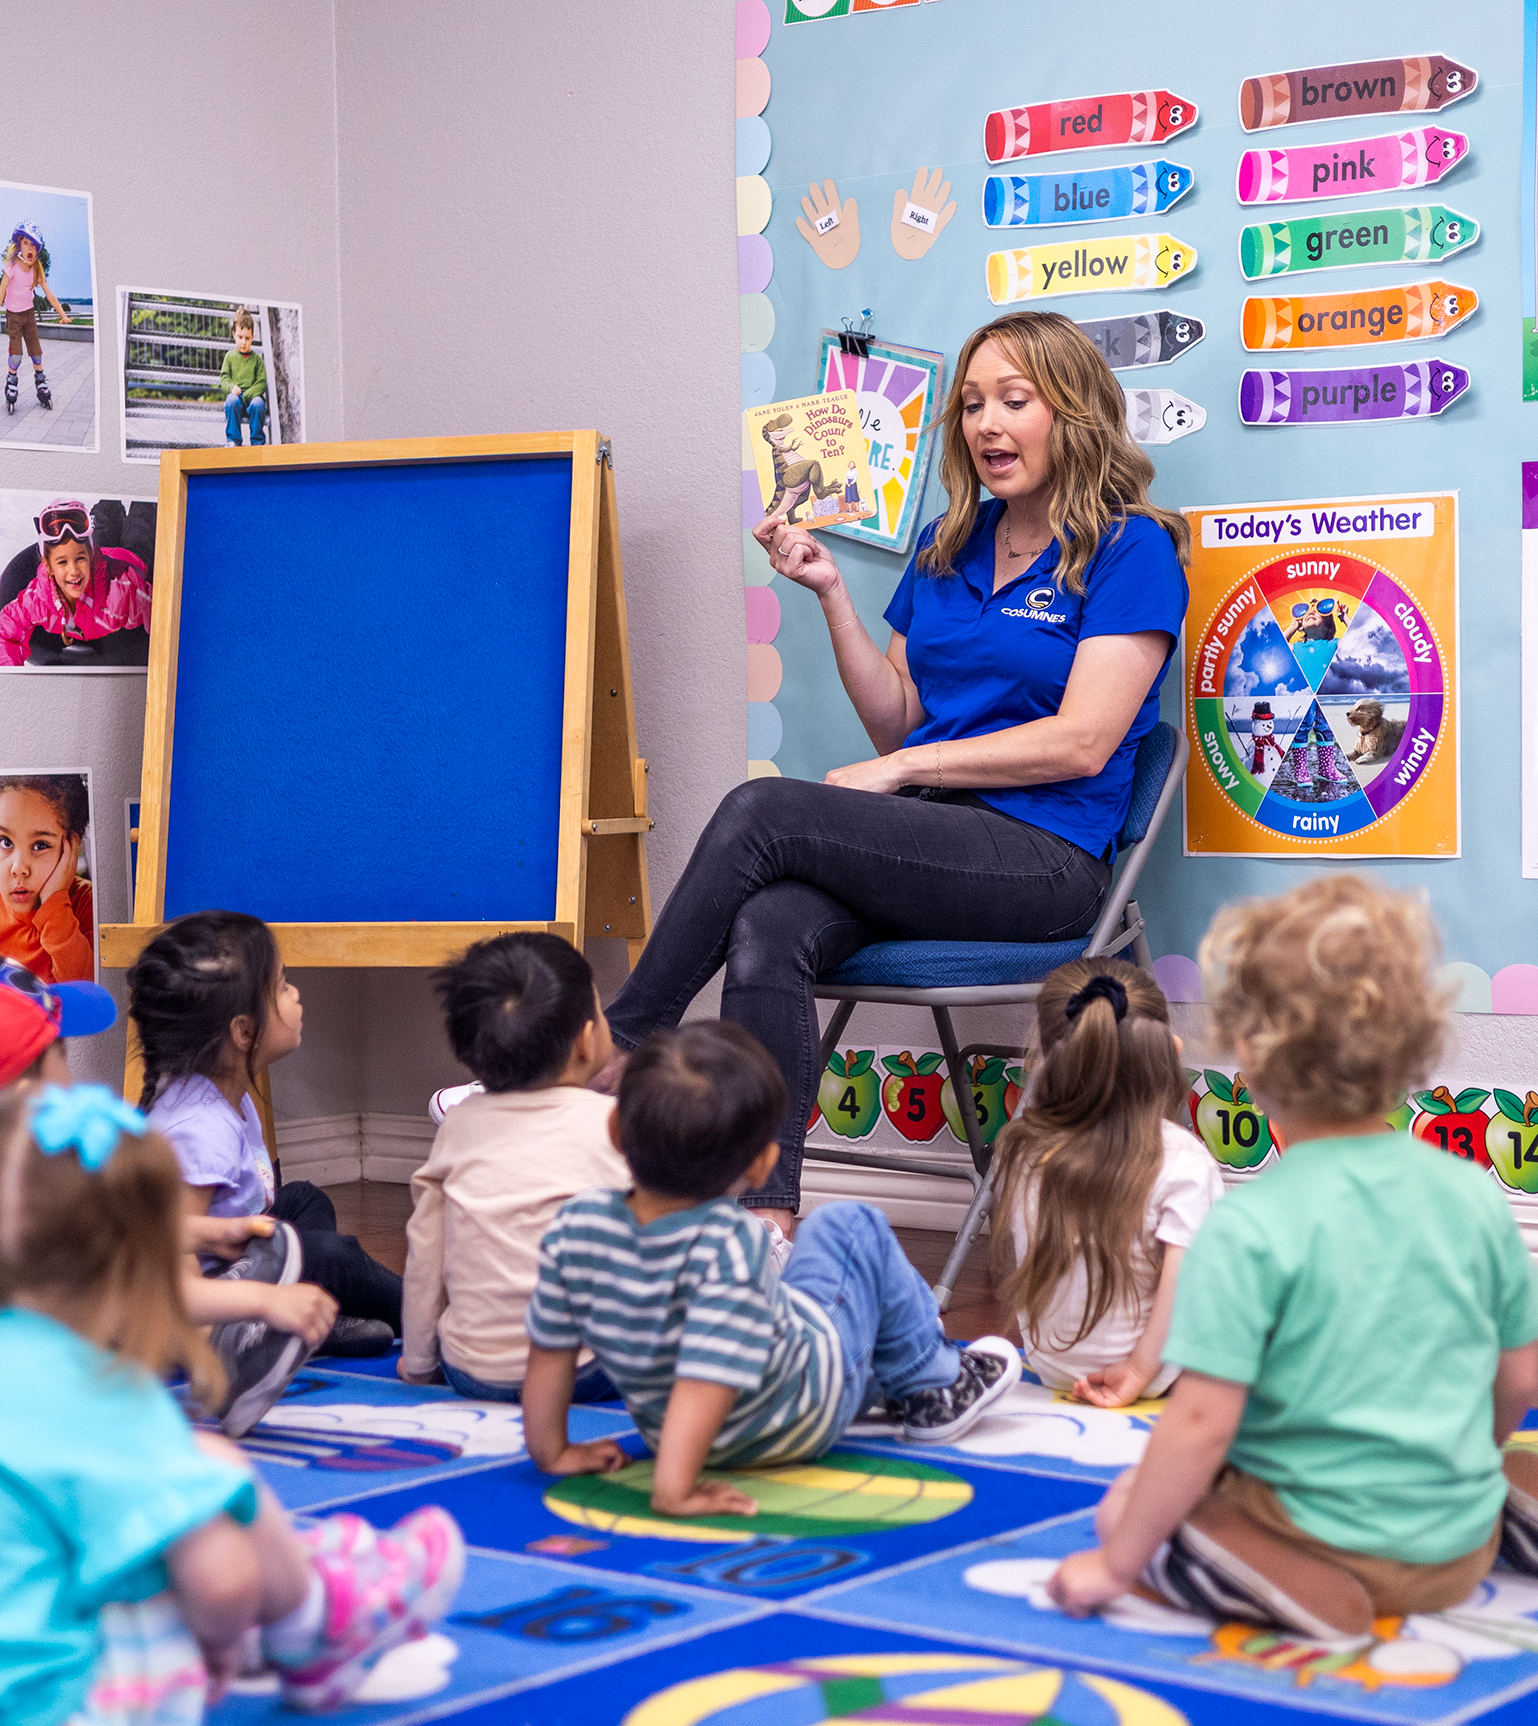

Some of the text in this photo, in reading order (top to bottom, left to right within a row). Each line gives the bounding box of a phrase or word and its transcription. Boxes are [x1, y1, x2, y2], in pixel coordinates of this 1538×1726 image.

[1301, 75, 1397, 107] brown
[1059, 104, 1103, 136] red
[1312, 149, 1376, 192] pink
[1054, 182, 1111, 212] blue
[819, 217, 834, 231] Left
[909, 211, 929, 226] Right
[1305, 223, 1389, 261] green
[1041, 249, 1129, 291] yellow
[1297, 303, 1404, 336] orange
[754, 409, 771, 417] JANE
[772, 405, 794, 414] YOLEN
[801, 400, 821, 408] MARK
[822, 394, 849, 404] TEAGUE
[1302, 373, 1397, 414] purple
[803, 415, 854, 436] Dinosaurs
[805, 404, 847, 421] How Do
[813, 427, 846, 441] Count
[826, 438, 837, 447] to
[820, 445, 845, 459] Ten?
[1214, 507, 1423, 543] Today's Weather
[1286, 560, 1341, 580] sunny
[1001, 607, 1067, 623] COSUMNES
[1200, 585, 1257, 693] partly sunny
[1394, 602, 1434, 665] cloudy
[1203, 730, 1240, 790] snowy
[1394, 727, 1436, 787] windy
[1292, 813, 1340, 838] rainy
[837, 1085, 861, 1119] 4
[906, 1088, 926, 1122] 5
[973, 1091, 989, 1126] 6
[1216, 1109, 1260, 1148] 10
[1434, 1126, 1474, 1163] 13
